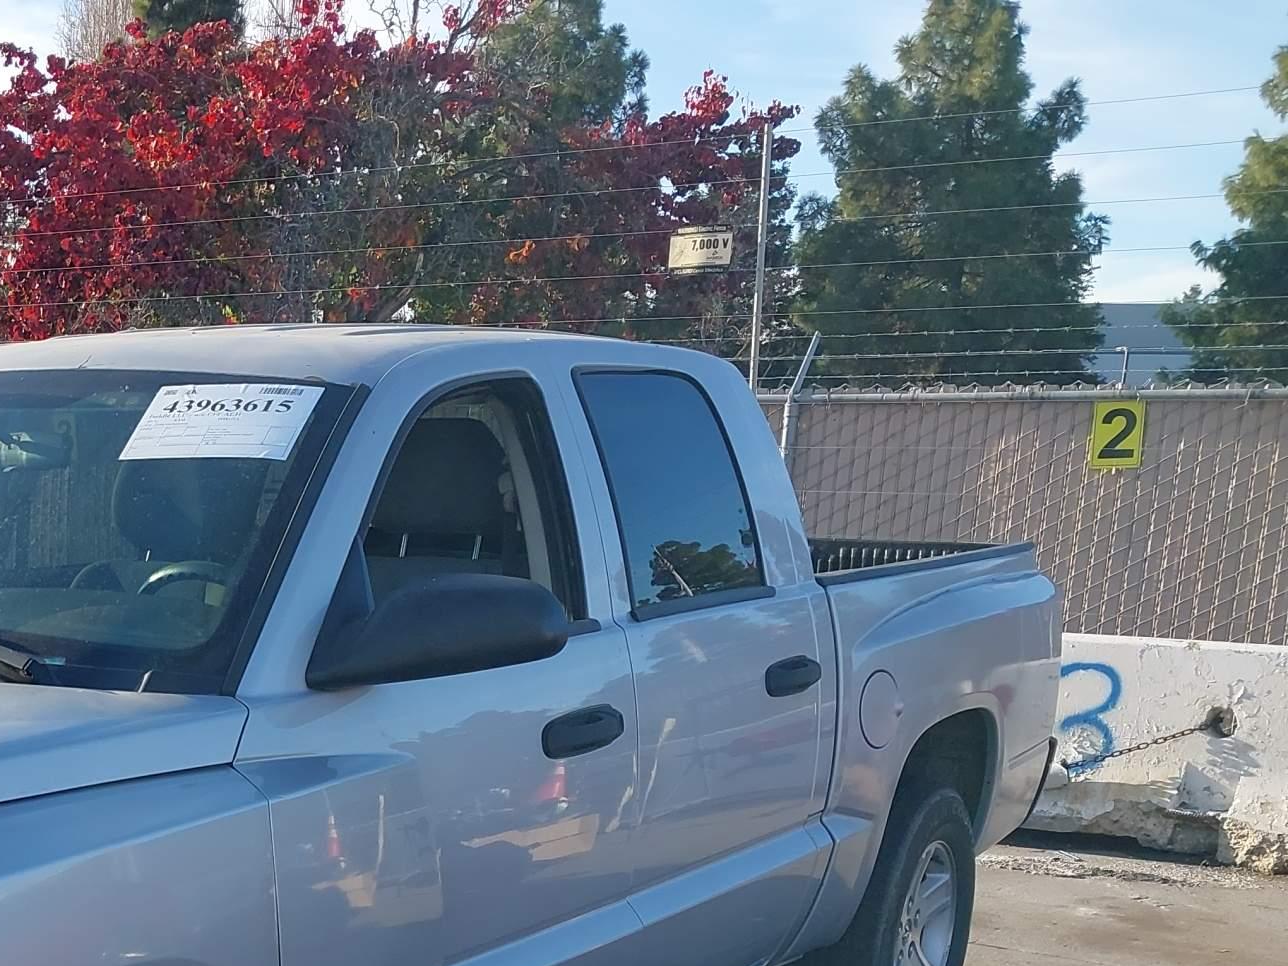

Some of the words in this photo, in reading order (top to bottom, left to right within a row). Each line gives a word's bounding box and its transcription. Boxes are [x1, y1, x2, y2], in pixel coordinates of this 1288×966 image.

[691, 237, 720, 252] 7,000
[722, 237, 730, 249] V
[162, 398, 295, 414] 43963615
[1097, 407, 1138, 459] 2
